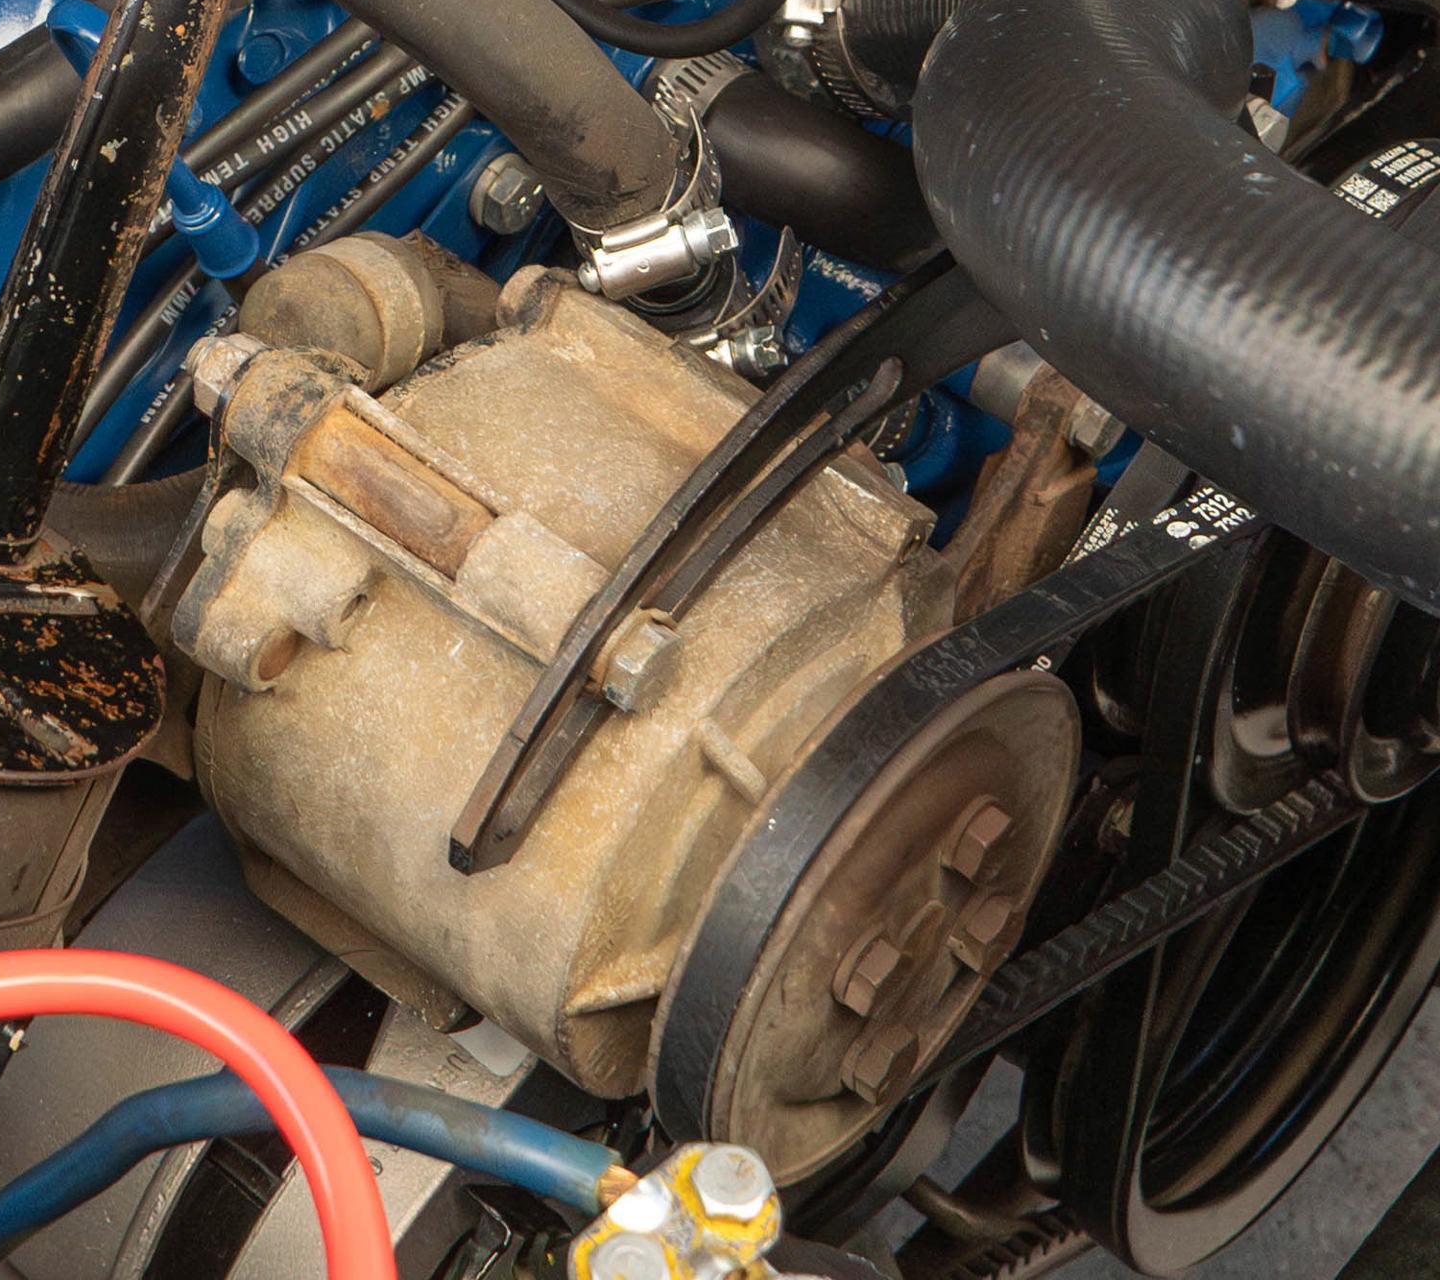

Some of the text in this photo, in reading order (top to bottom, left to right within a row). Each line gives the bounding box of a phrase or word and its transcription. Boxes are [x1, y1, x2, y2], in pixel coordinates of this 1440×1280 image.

[200, 110, 313, 187] HIGH TEM
[369, 136, 419, 184] TEMP
